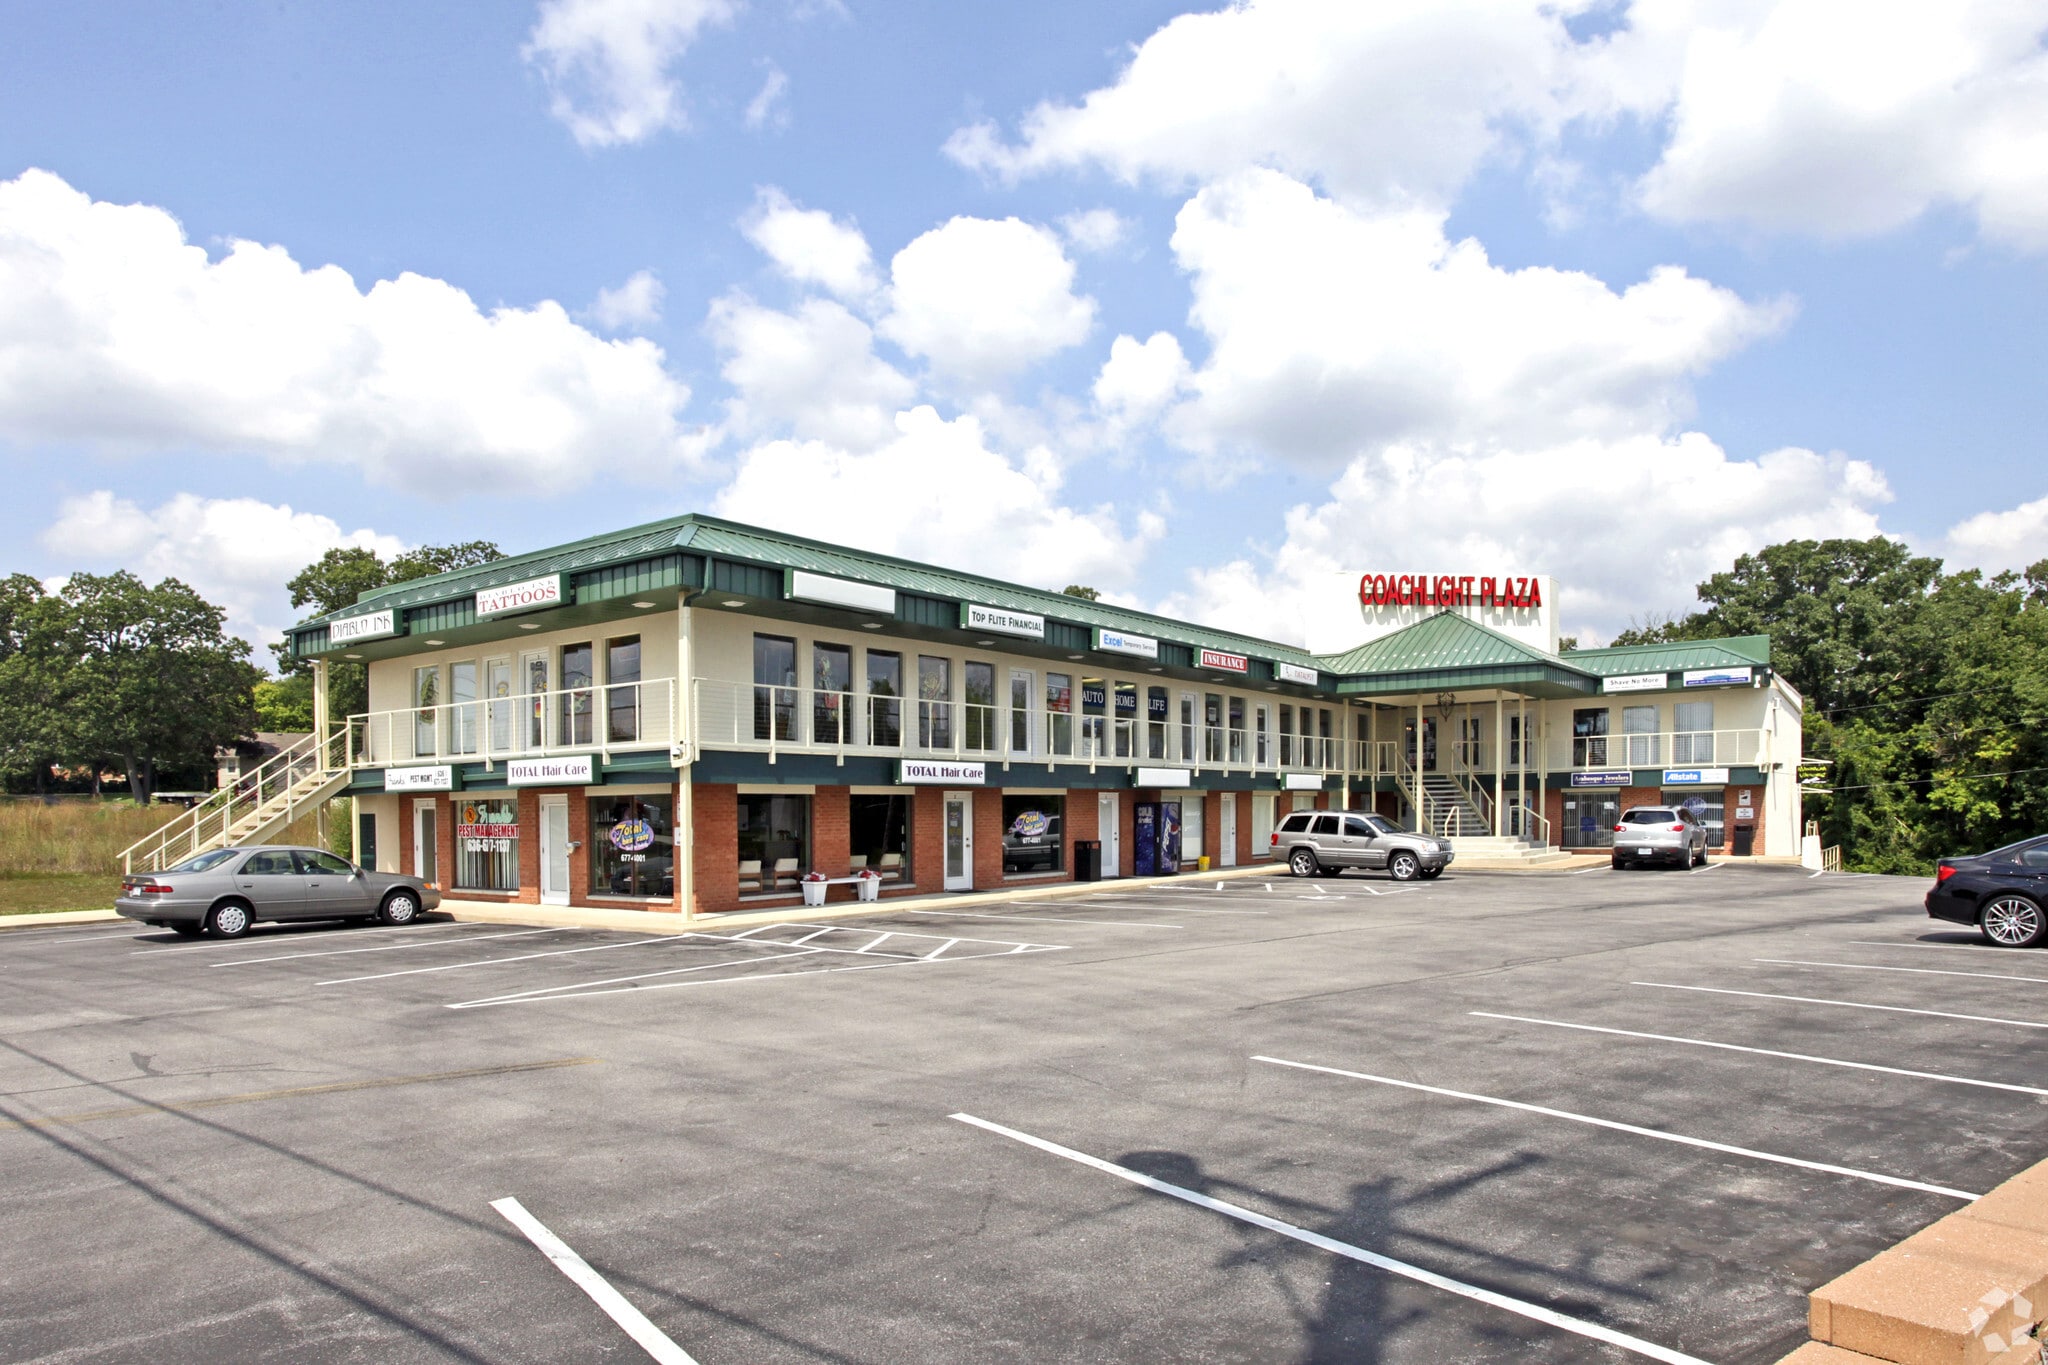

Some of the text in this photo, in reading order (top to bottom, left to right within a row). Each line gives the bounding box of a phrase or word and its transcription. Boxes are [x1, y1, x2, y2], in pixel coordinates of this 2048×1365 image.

[1360, 574, 1542, 608] COACHLIGHT PLAZA
[479, 586, 556, 612] TATTOOS
[332, 615, 391, 639] DIABLO INK
[971, 611, 1042, 632] TOP FLITE FINANCIAL
[1103, 633, 1123, 647] Excel
[1204, 653, 1245, 670] INSURANCE
[1082, 690, 1104, 704] AUTO
[1115, 694, 1135, 708] HOME
[1148, 698, 1166, 711] LIFE
[511, 763, 588, 778] TOTAL Hair Care
[905, 765, 983, 778] TOTAL Hair Care
[1667, 772, 1699, 781] Allstate
[458, 824, 520, 838] PEST MANAGEMENT
[616, 819, 643, 842] Total
